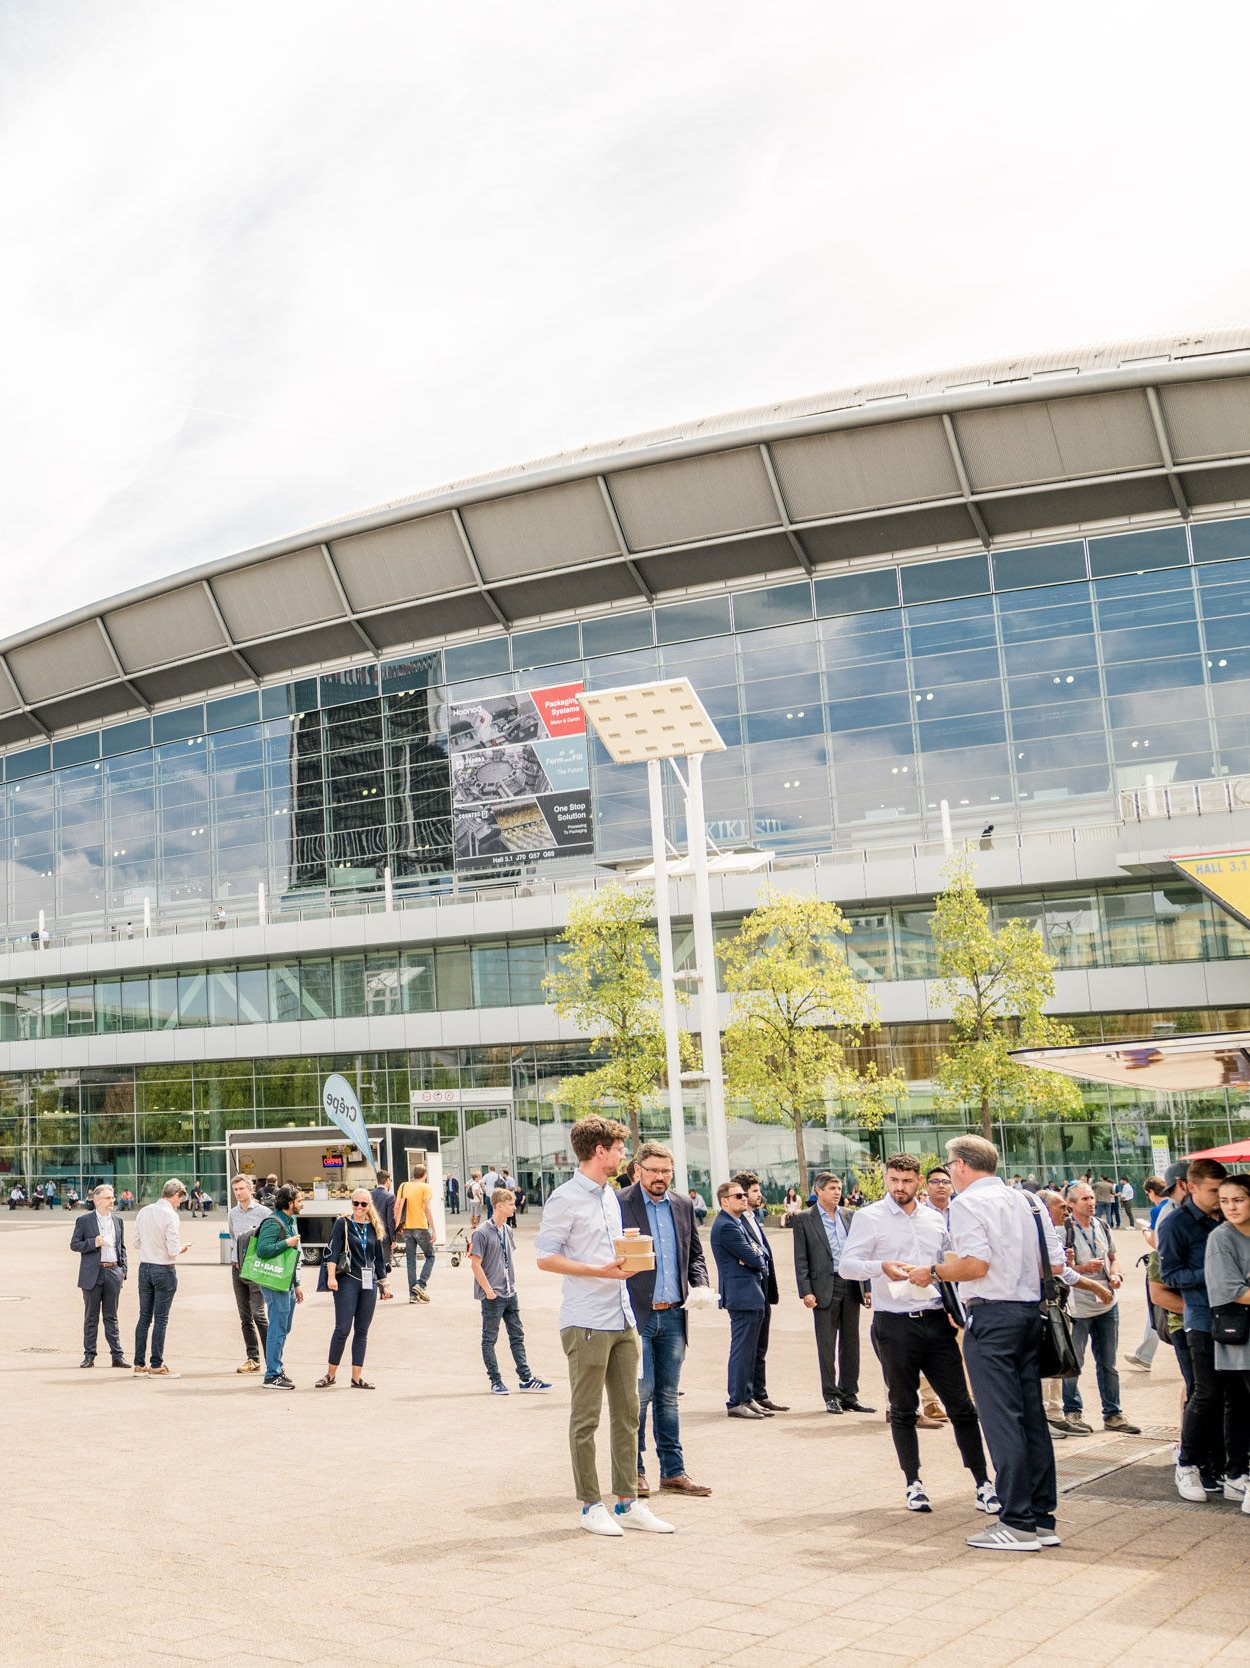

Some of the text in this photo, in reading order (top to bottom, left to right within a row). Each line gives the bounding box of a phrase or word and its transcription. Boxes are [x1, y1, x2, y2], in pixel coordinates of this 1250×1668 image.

[551, 706, 580, 716] Systems
[546, 757, 564, 766] Form
[572, 753, 582, 761] Fill
[553, 803, 586, 813] One Stop
[557, 812, 587, 821] Solution
[1195, 860, 1247, 874] HALL 3.1
[264, 1262, 284, 1273] BASF
